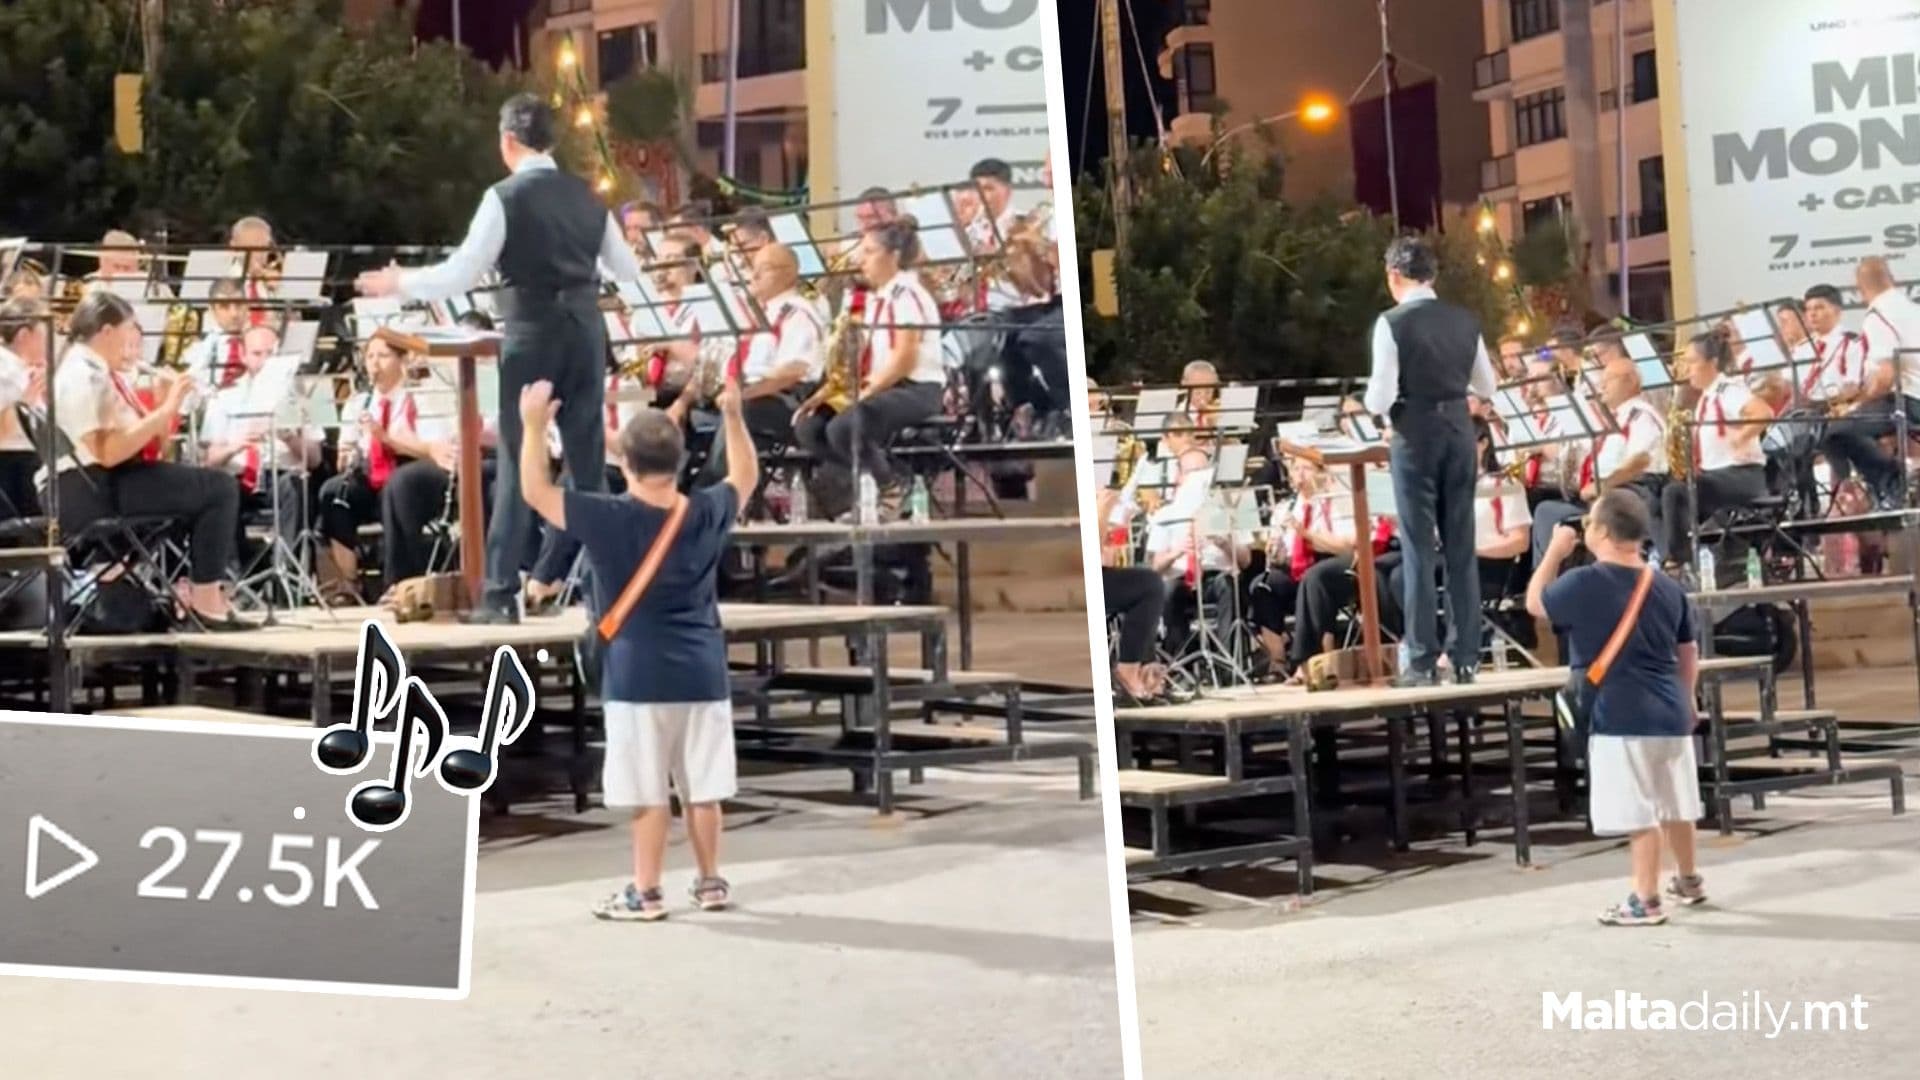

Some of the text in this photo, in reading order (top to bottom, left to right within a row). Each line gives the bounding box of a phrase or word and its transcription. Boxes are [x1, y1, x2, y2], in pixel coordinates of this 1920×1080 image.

[1811, 52, 1920, 115] MI
[927, 98, 962, 125] 7
[984, 126, 1031, 137] PUBLIC
[1712, 113, 1920, 186] MON
[1769, 234, 1799, 260] 7
